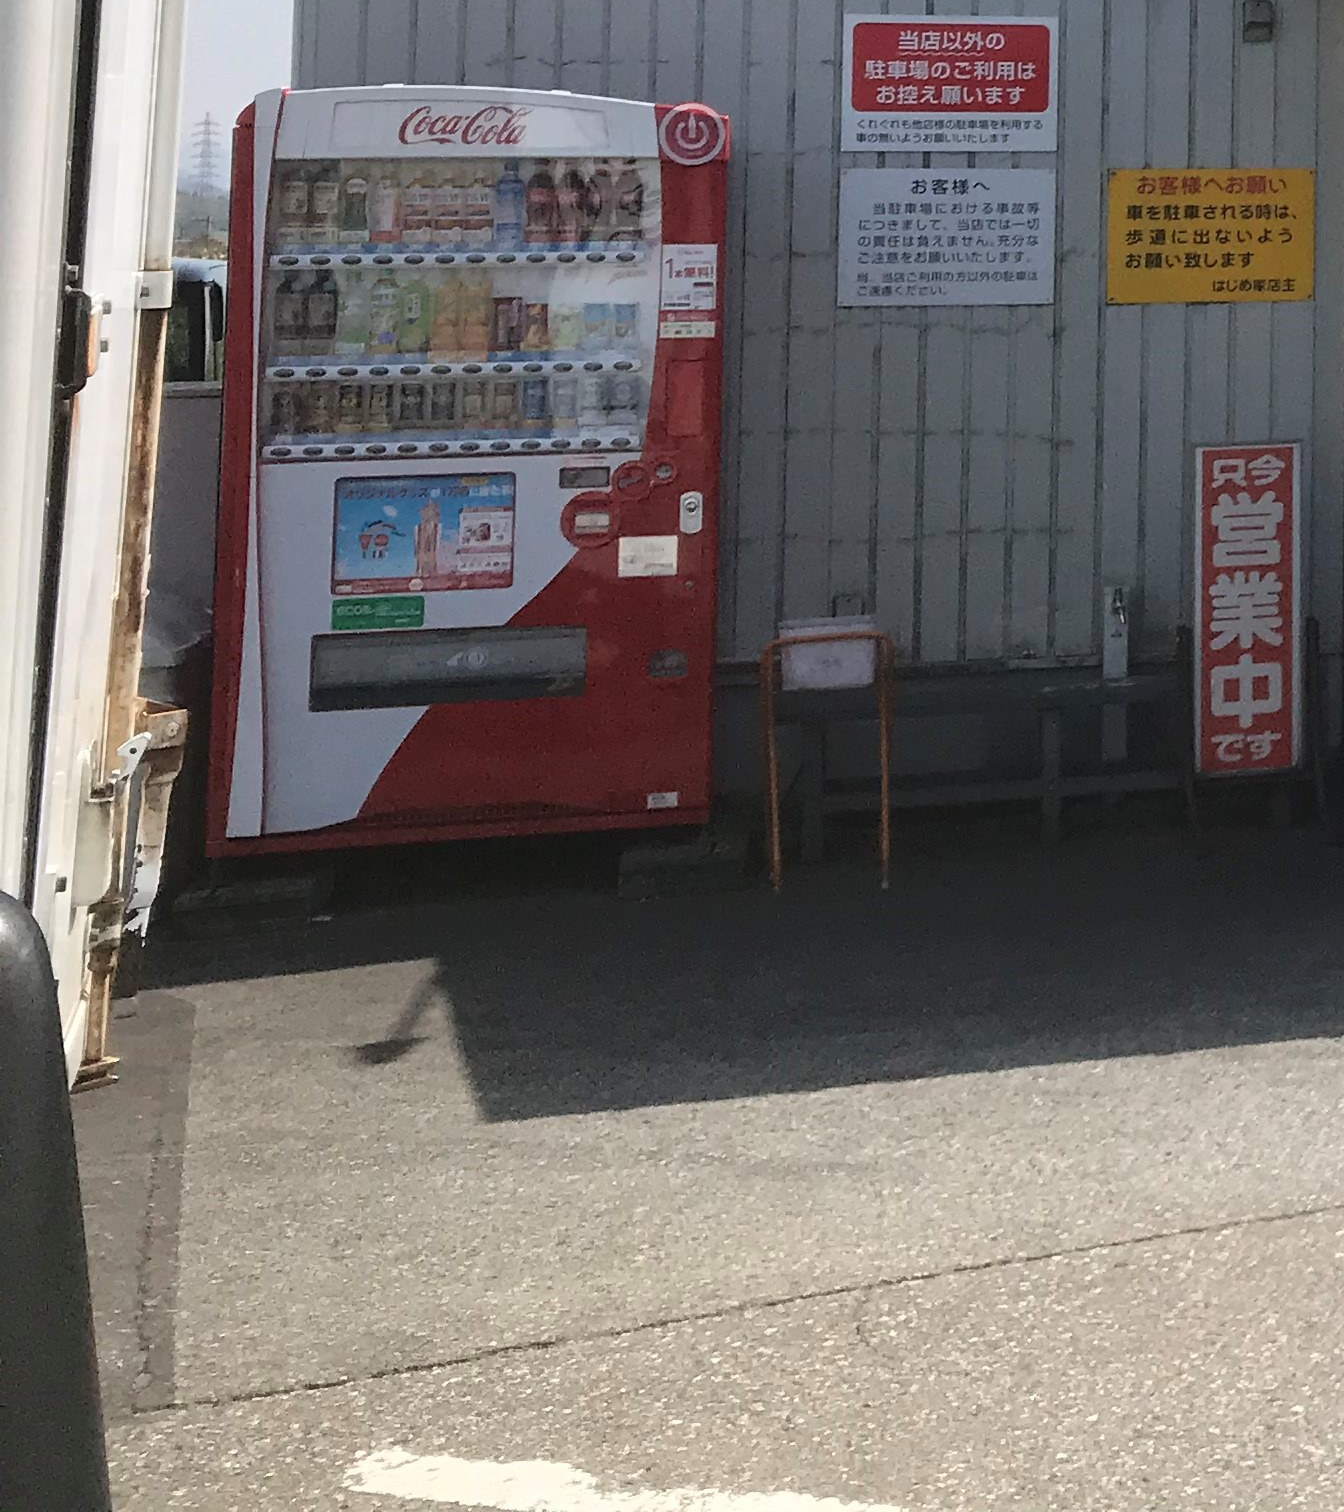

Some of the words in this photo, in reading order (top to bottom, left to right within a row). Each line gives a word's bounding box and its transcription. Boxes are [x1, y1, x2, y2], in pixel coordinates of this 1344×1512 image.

[898, 30, 1005, 50] 当店以外の
[864, 60, 1036, 80] 駐車場のご利用は
[876, 85, 1025, 105] お控え願います
[398, 105, 535, 145] Coca-Cola
[911, 178, 990, 195] お客様へ
[1137, 176, 1287, 196] お客様へお願い
[1126, 204, 1297, 221] 車を駐車される時は、
[1126, 229, 1294, 245] 歩道に出ないよう
[1125, 252, 1254, 269] お願い致します
[1212, 278, 1296, 292] はじめ家店主
[1212, 454, 1285, 488] 只今
[1209, 490, 1284, 729] 営業中
[1211, 730, 1281, 762] です
